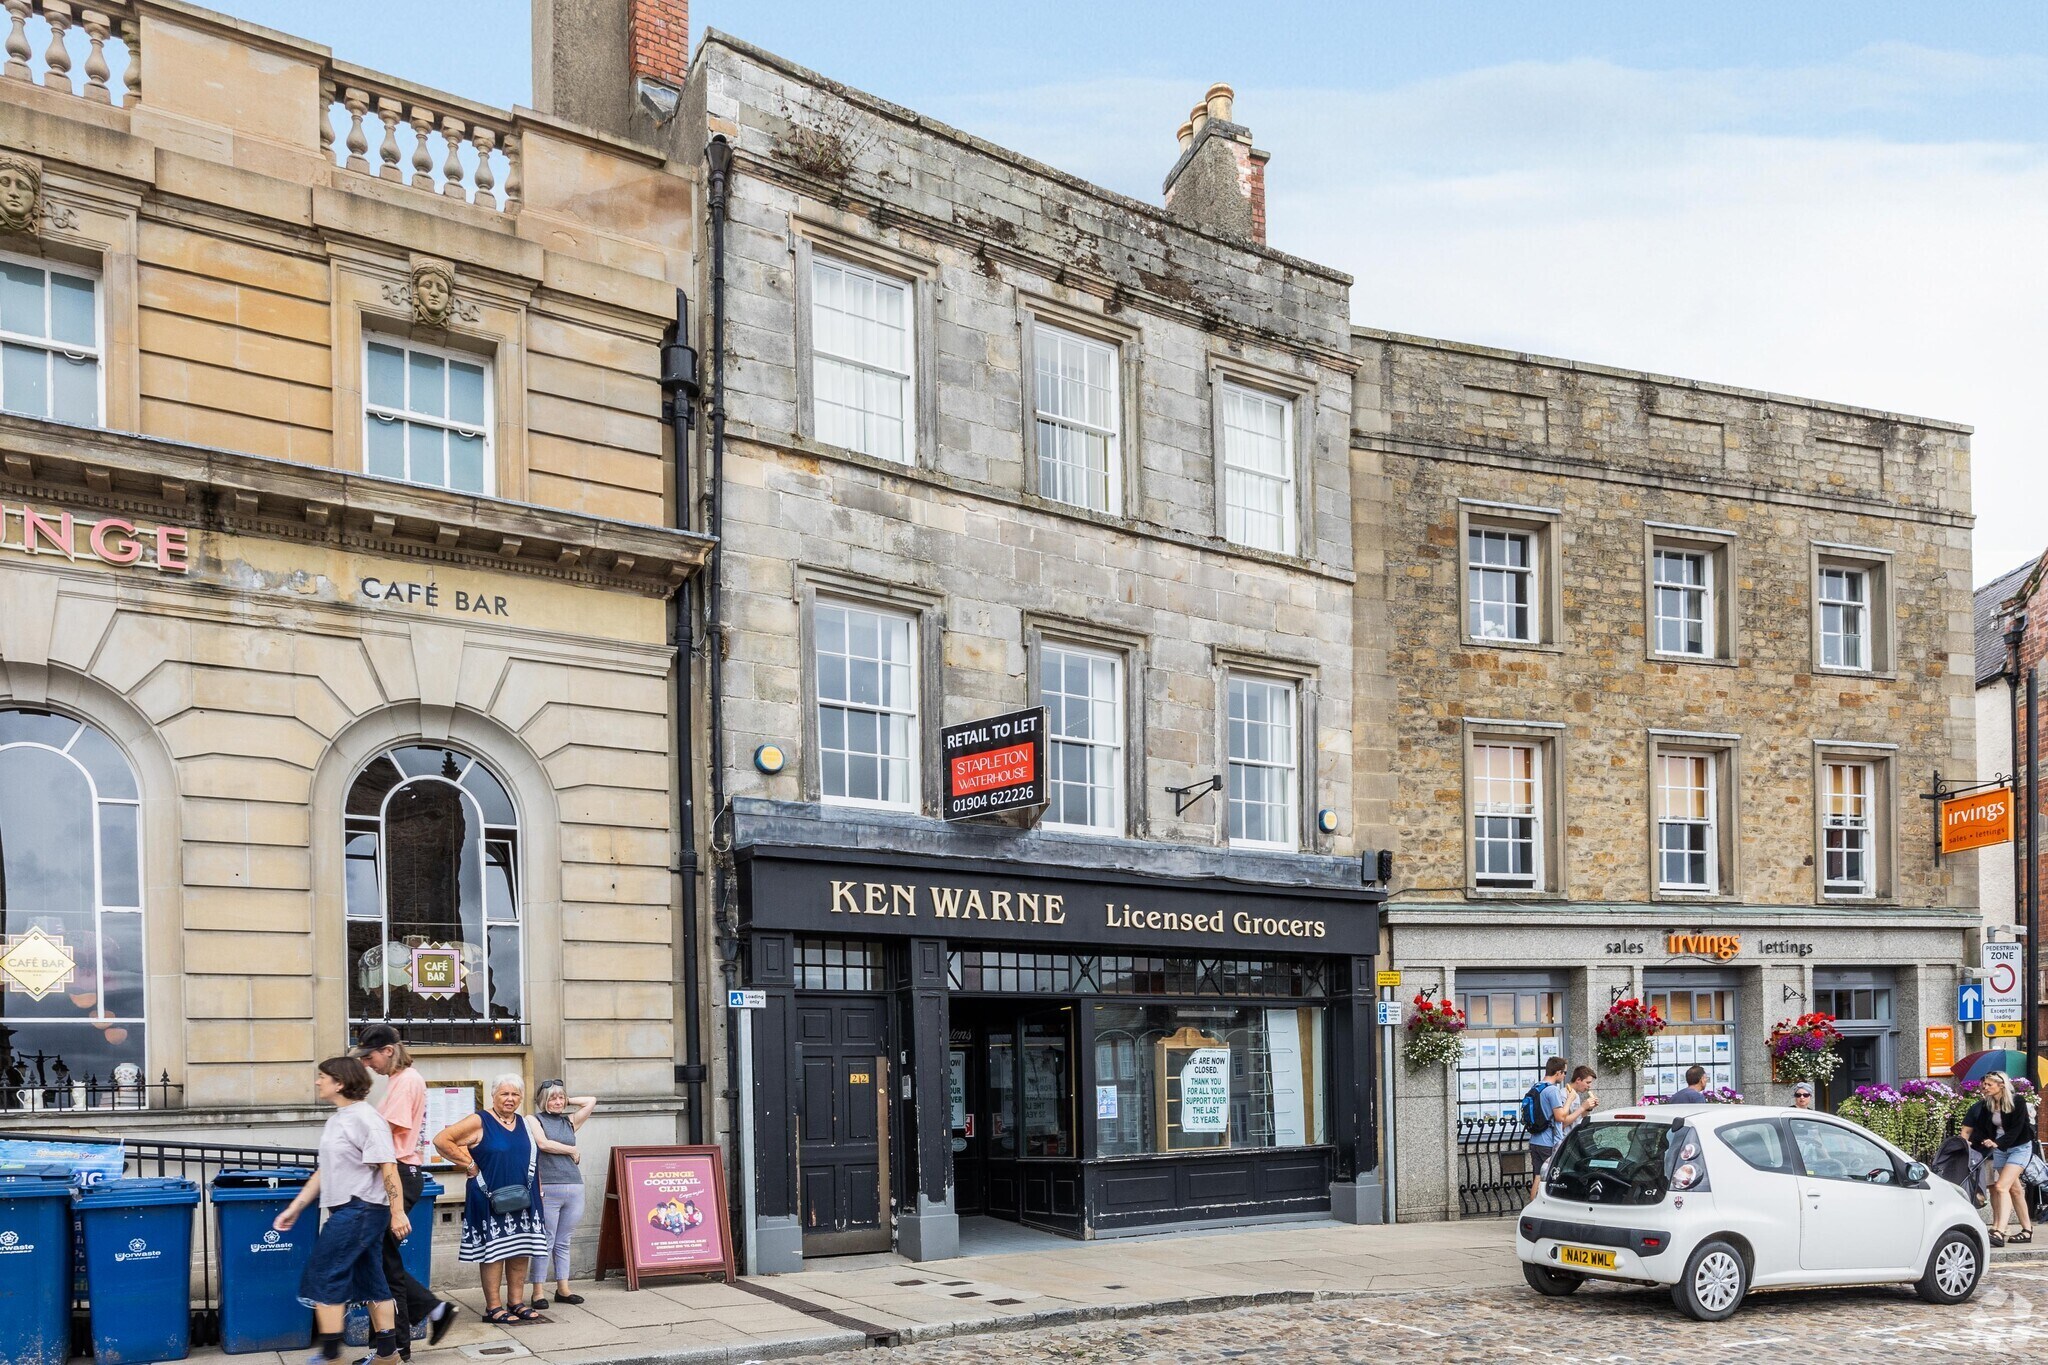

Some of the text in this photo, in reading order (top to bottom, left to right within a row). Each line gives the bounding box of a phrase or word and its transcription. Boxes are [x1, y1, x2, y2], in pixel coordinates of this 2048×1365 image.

[0, 504, 189, 574] NGE
[361, 577, 509, 617] CAFÉ BAR
[947, 717, 1037, 749] RETAIL TO LET
[957, 749, 1028, 775] STAPLETON
[958, 766, 1028, 790] WATERHOUSE
[953, 785, 1034, 812] 01904 622226
[1948, 801, 2005, 826] irvings
[1948, 828, 2005, 843] sales lettings
[830, 880, 1066, 924] KEN WARNE
[1105, 903, 1326, 938] Licensed Grocers
[1606, 940, 1644, 955] sales
[1667, 931, 1741, 960] irvings
[1759, 940, 1813, 957] lettings
[42, 959, 65, 968] BAR
[1991, 952, 2014, 960] ZONE
[424, 960, 448, 971] CAFÉ
[427, 972, 445, 981] BAR
[1199, 1057, 1210, 1065] ARE
[1211, 1057, 1226, 1065] NOW
[1194, 1066, 1218, 1074] CLOSED.
[1187, 1087, 1225, 1095] FOR ALL YOUR
[1213, 1096, 1227, 1104] OVER
[1200, 1116, 1220, 1124] YEARS.
[644, 1178, 701, 1186] COCKTAIL
[649, 1171, 694, 1179] LOUNGE
[659, 1185, 688, 1193] CLUB
[114, 1250, 161, 1262] yorwaste
[1566, 1249, 1611, 1267] NA12 WML
